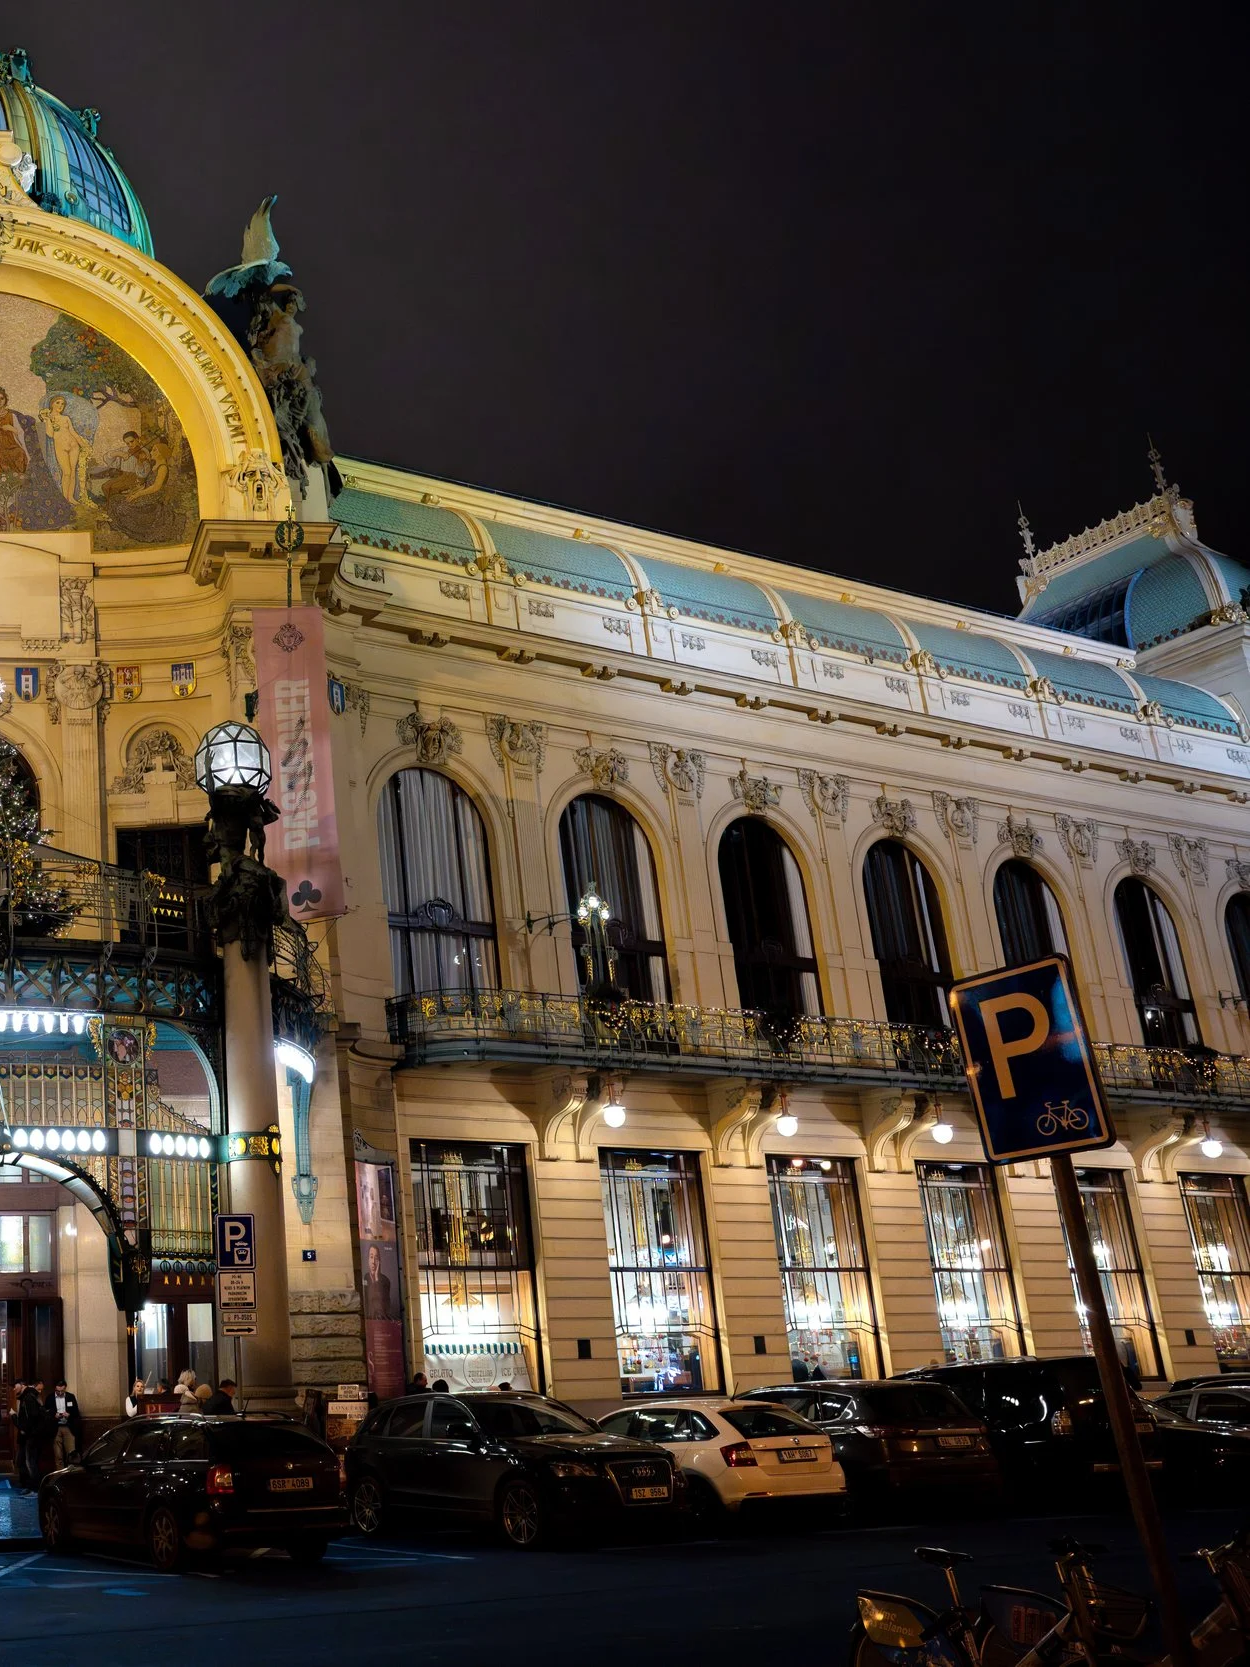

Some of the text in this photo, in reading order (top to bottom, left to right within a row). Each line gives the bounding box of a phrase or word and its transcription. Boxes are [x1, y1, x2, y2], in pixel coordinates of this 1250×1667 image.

[12, 237, 49, 257] JAK
[978, 992, 1050, 1100] P
[224, 1221, 246, 1252] P
[429, 1368, 454, 1378] GELATO
[271, 1478, 310, 1489] 6SR 4089
[634, 1488, 646, 1498] 1SZ
